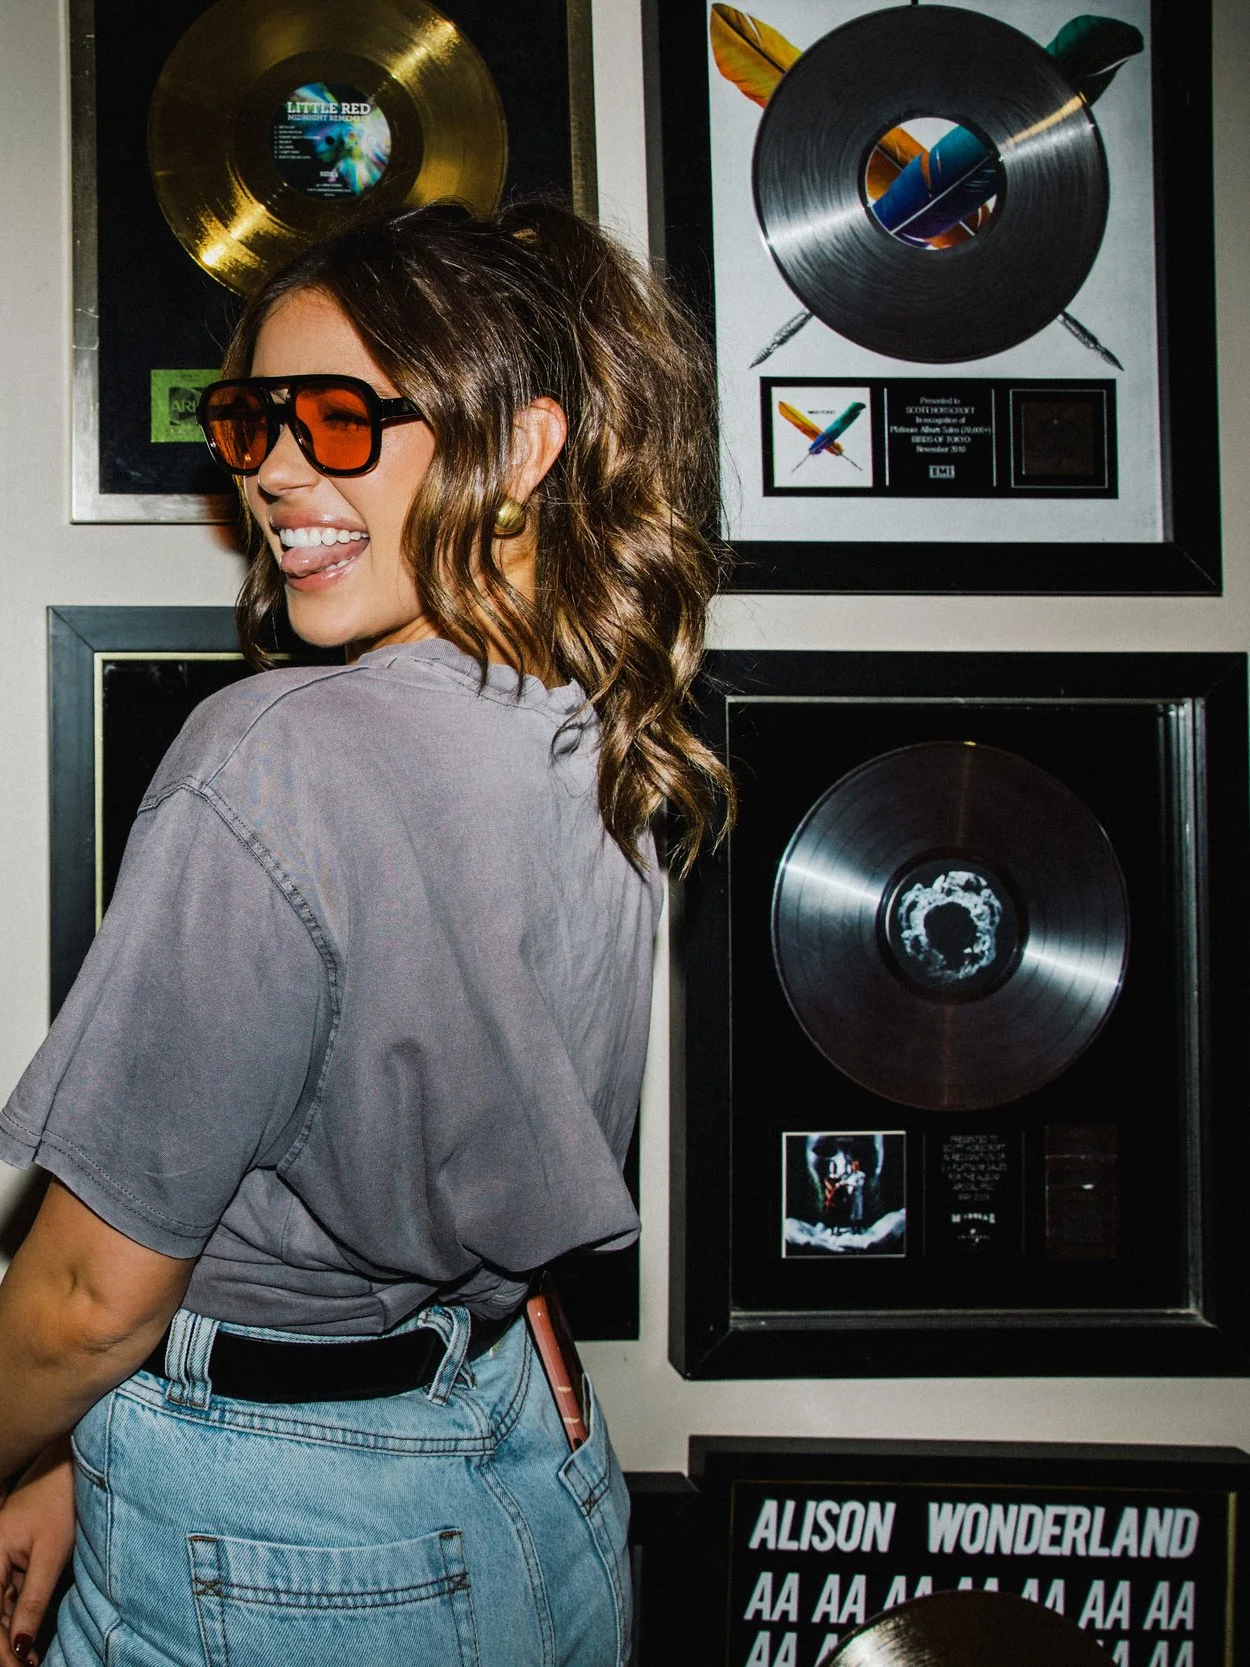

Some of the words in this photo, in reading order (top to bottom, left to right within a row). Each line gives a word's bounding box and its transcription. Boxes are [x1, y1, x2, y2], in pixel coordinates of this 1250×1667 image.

[287, 102, 338, 114] LITTLE
[341, 103, 371, 115] RED
[920, 396, 952, 404] Presented
[905, 406, 929, 415] SCOTT
[890, 426, 919, 434] Platinum
[920, 426, 940, 434] Album
[941, 426, 960, 434] Sales
[915, 445, 949, 454] November
[930, 466, 954, 478] EMI
[748, 1498, 897, 1554] ALISON
[927, 1501, 1201, 1560] WONDERLAND
[743, 1571, 799, 1622] AA
[810, 1574, 867, 1625] AA
[1077, 1579, 1131, 1631] AA
[1142, 1580, 1195, 1631] AA
